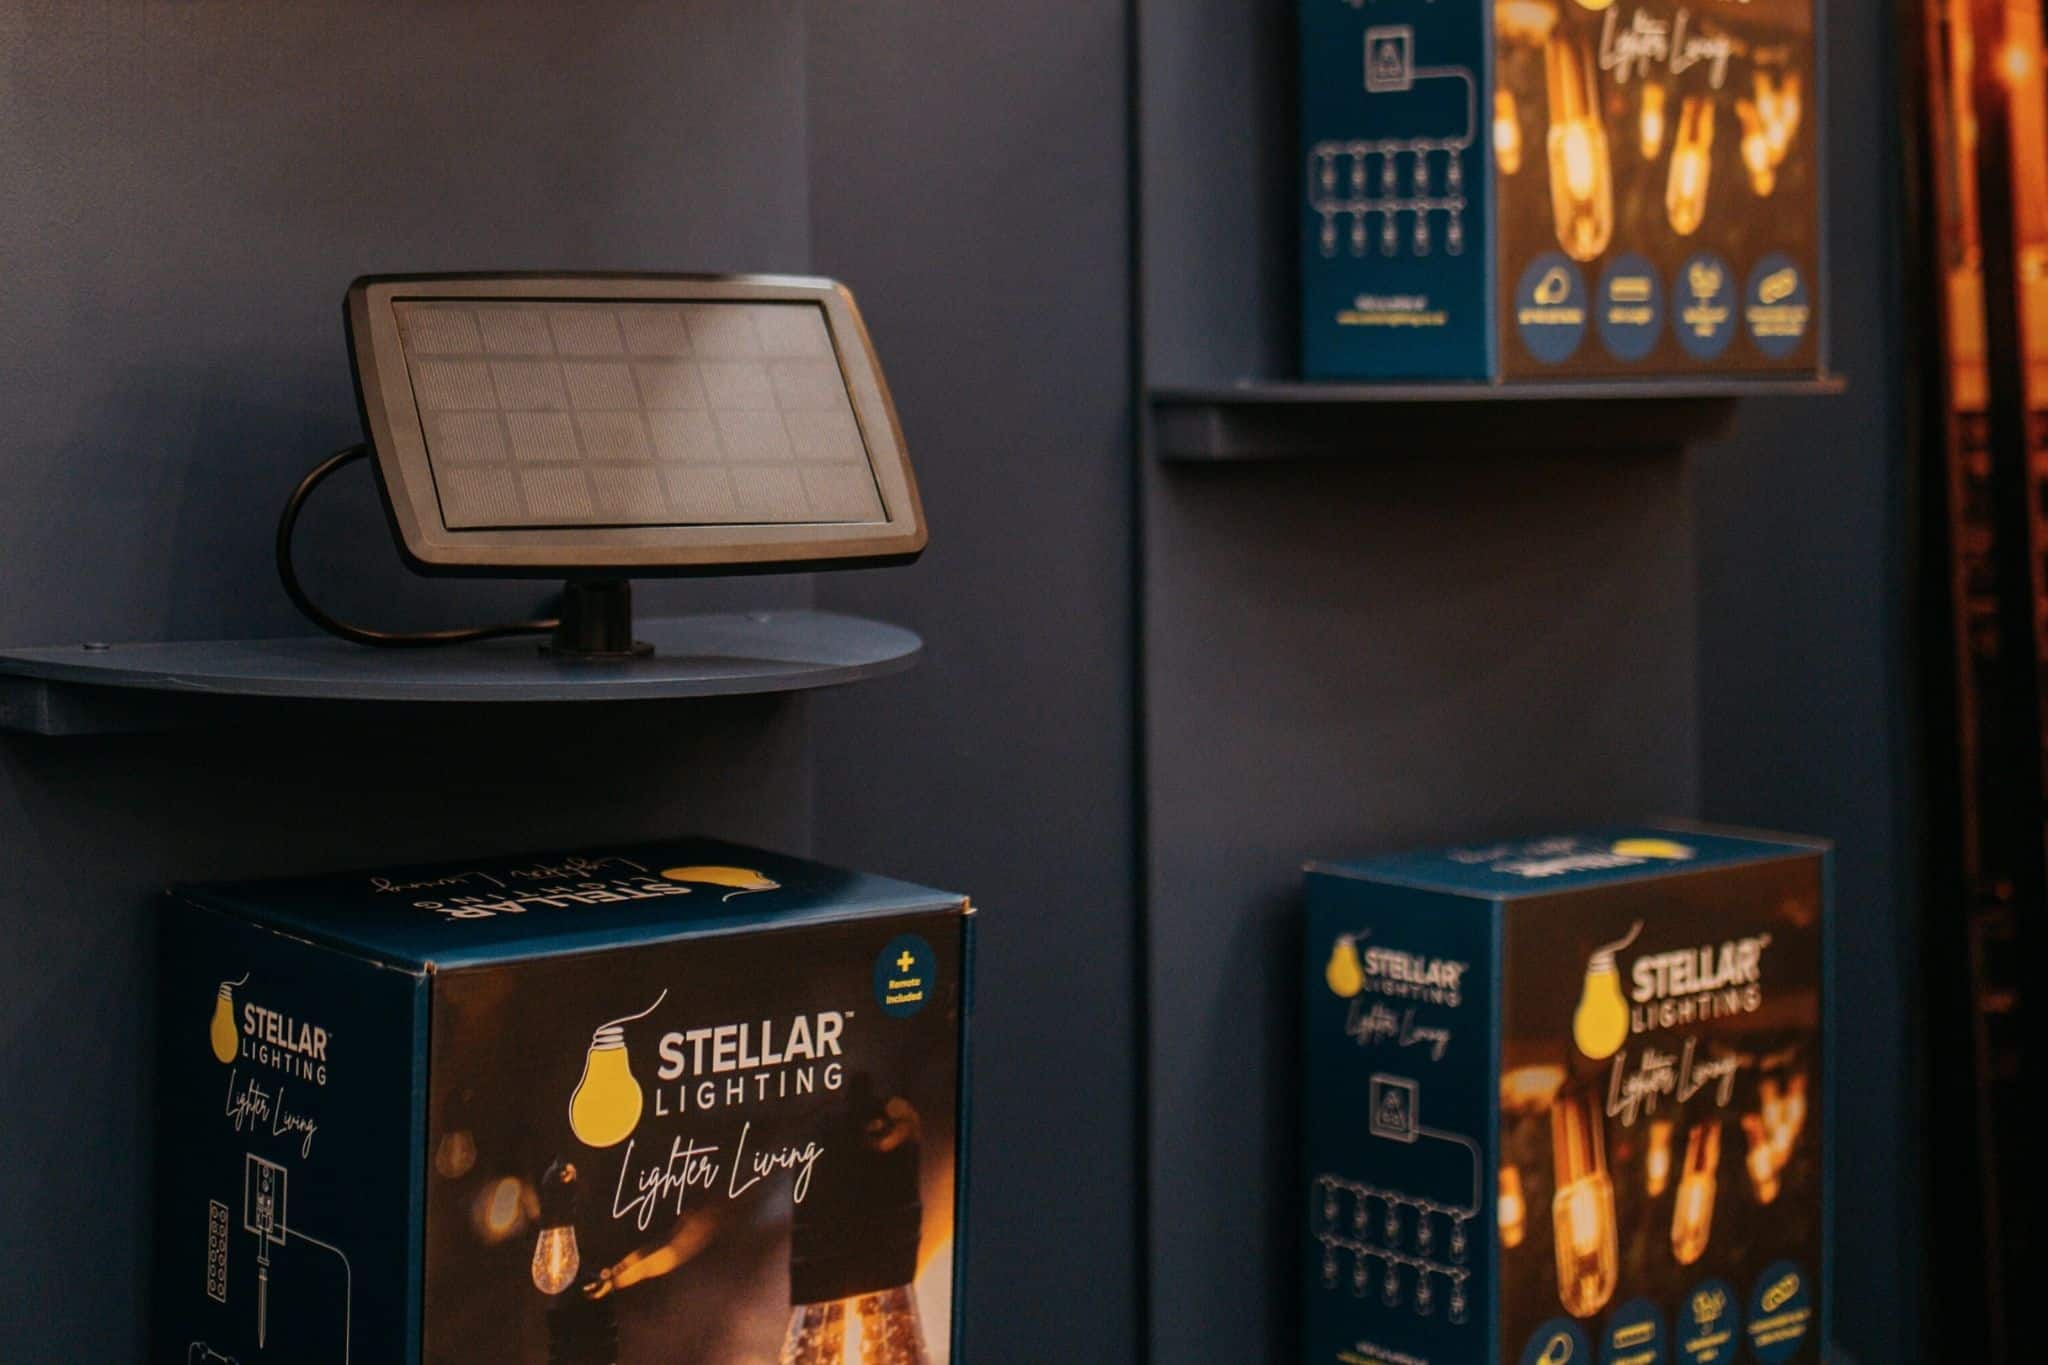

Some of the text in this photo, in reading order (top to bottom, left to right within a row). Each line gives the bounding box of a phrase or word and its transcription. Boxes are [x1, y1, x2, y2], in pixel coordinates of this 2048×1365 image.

[413, 876, 659, 910] LIGHTING
[436, 882, 691, 920] STELLAR
[1364, 946, 1461, 989] STELLAR
[1632, 937, 1760, 1003] STELLAR
[243, 1002, 327, 1062] STELLAR
[1631, 983, 1761, 1034] LIGHTING
[242, 1037, 327, 1086] LIGHTING
[226, 1068, 318, 1159] Lighter Living
[655, 1063, 843, 1117] LIGHTING
[613, 1121, 824, 1231] Lighter Living
